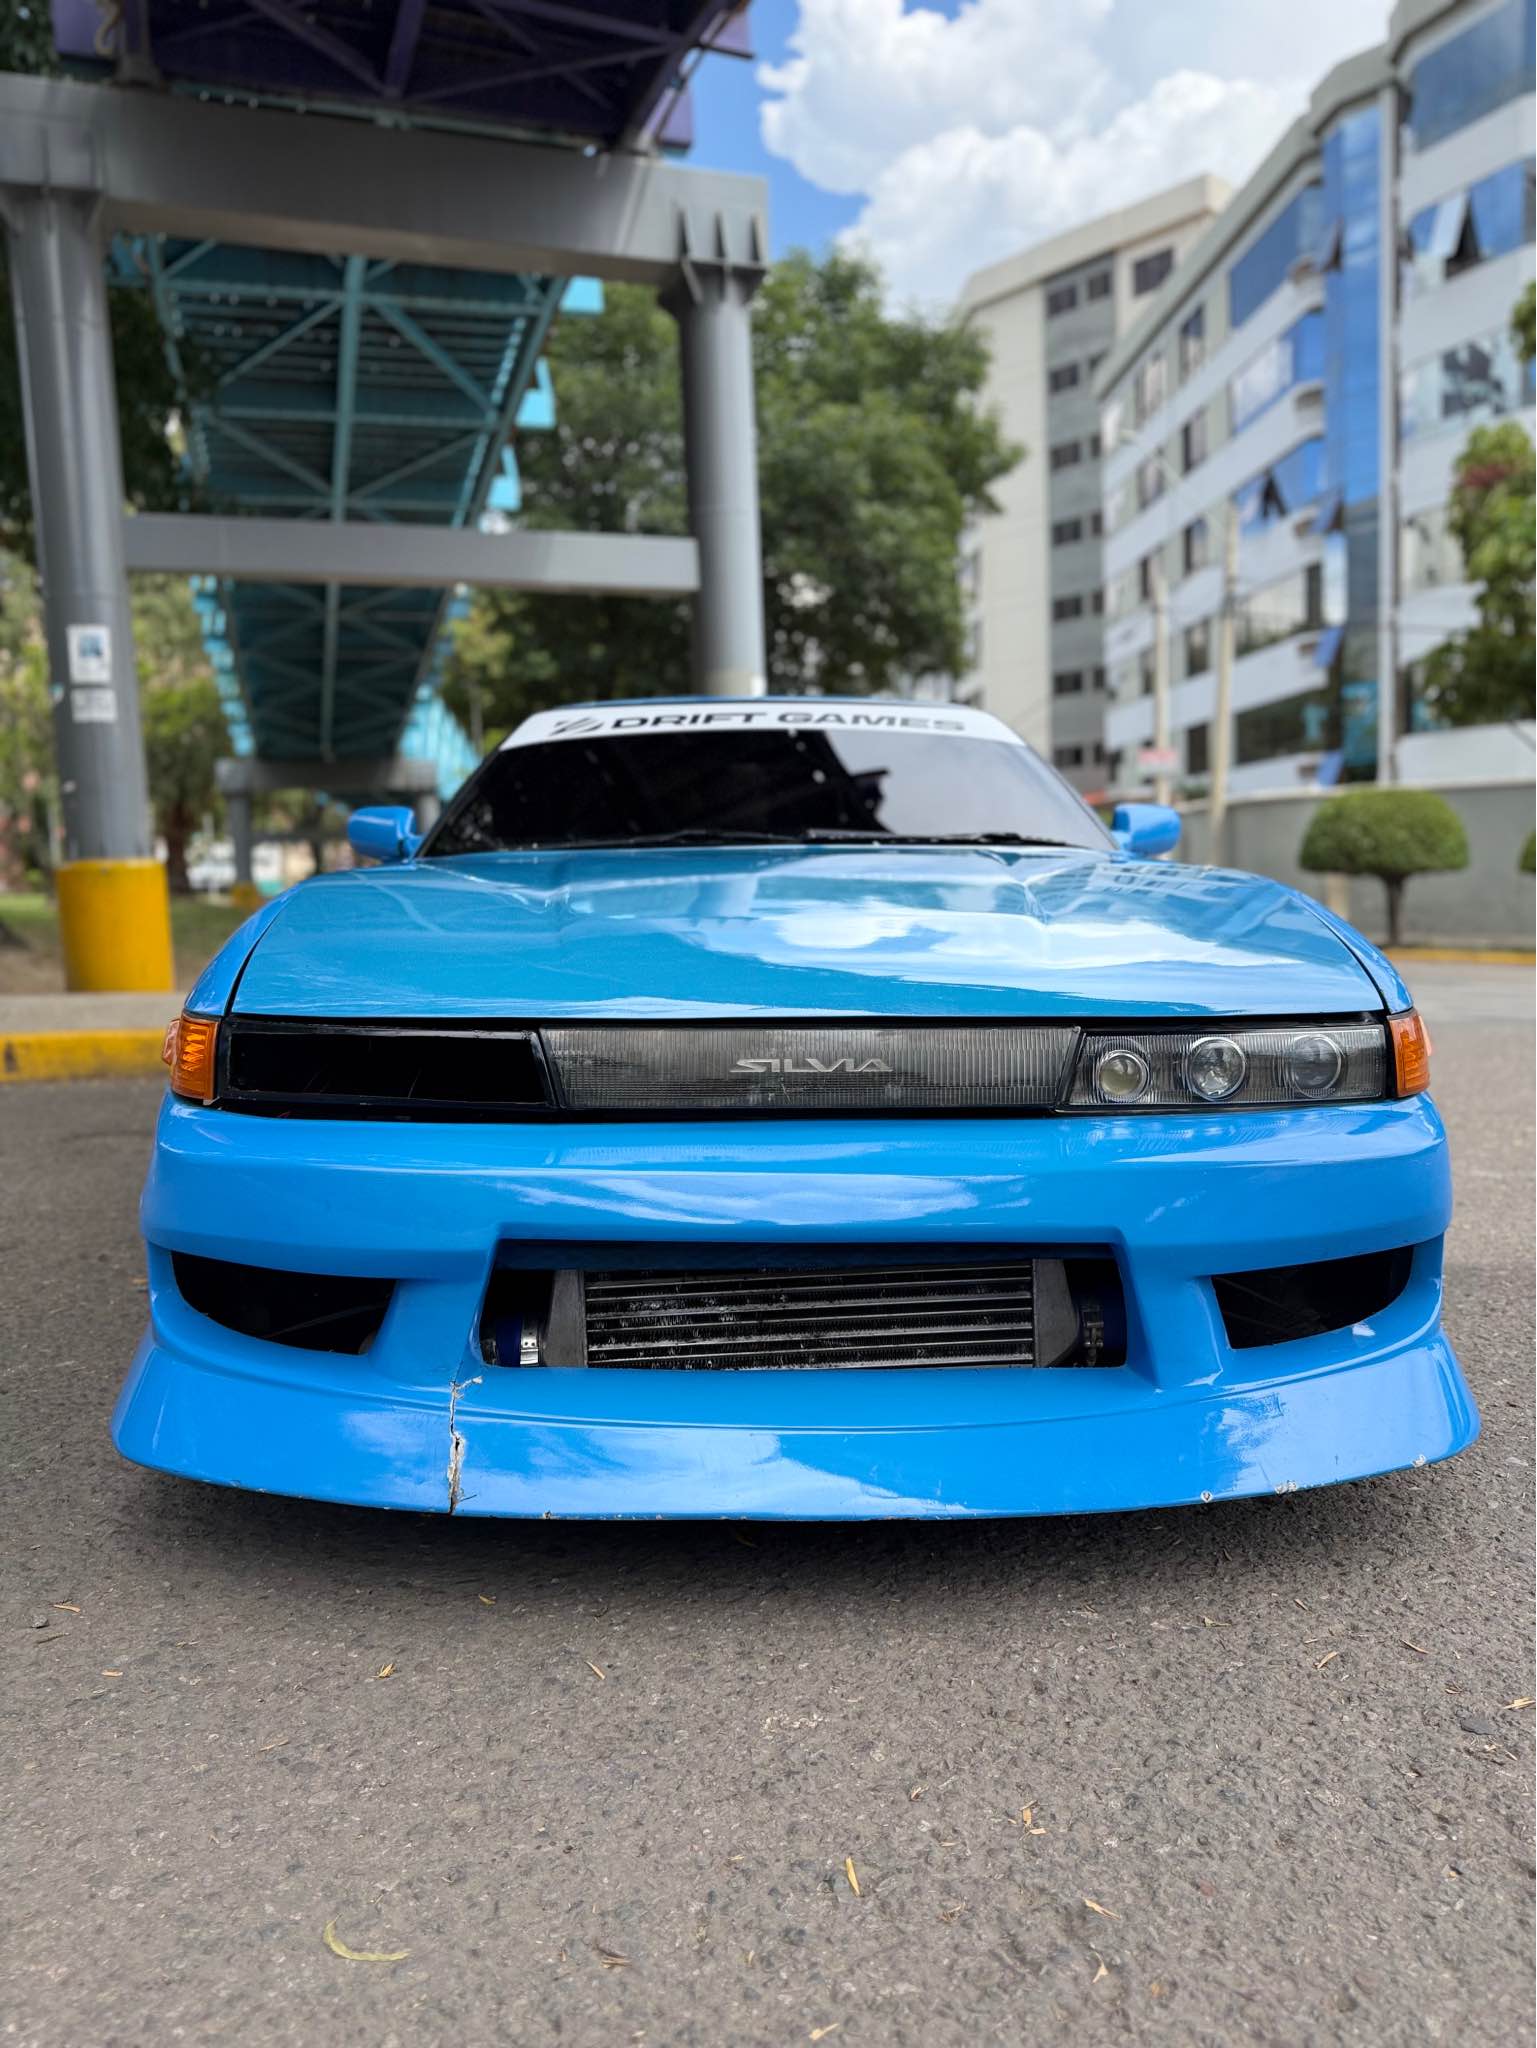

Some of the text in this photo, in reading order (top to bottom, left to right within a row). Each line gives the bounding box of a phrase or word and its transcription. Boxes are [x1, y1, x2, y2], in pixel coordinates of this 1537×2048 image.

[611, 711, 966, 731] DRIFT GAMES
[729, 1058, 894, 1073] SILVIA
